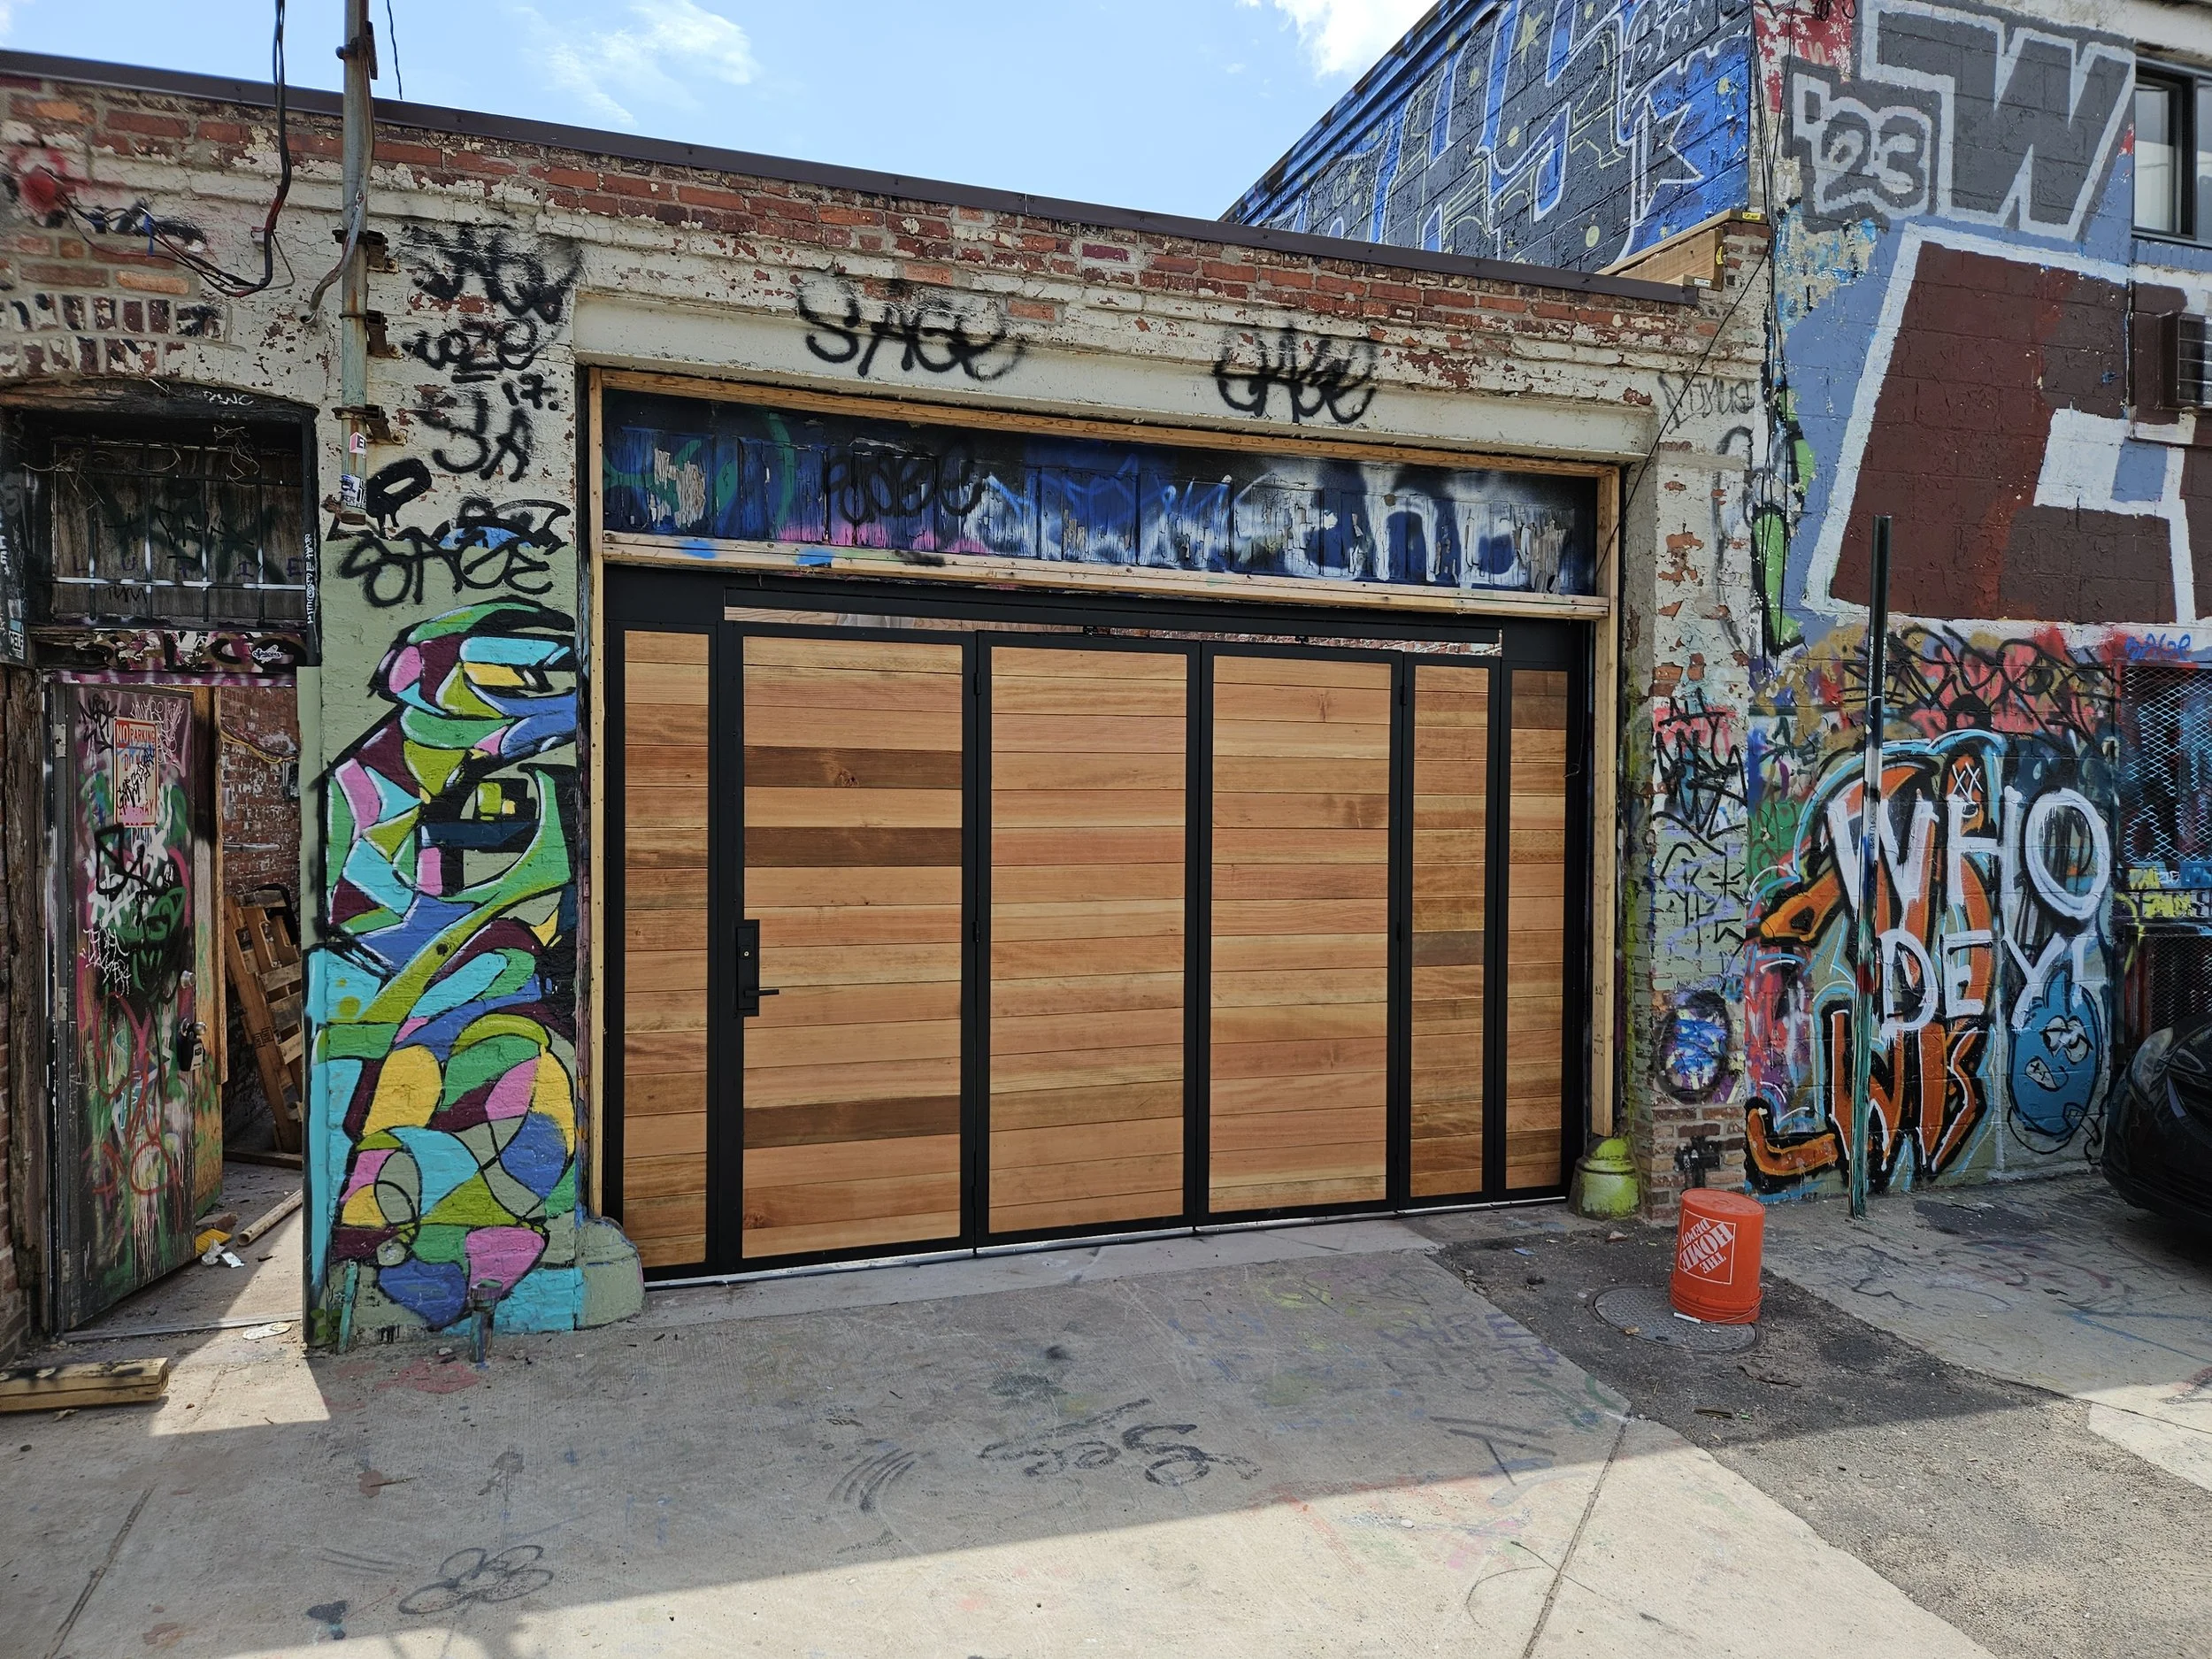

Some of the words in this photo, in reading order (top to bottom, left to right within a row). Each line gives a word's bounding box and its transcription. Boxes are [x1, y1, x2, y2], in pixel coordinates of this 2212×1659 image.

[117, 724, 129, 744] NO
[129, 728, 156, 744] PARKING
[1826, 785, 2111, 929] WHO
[1680, 1222, 1733, 1272] HOME
[1700, 1252, 1726, 1272] THE
